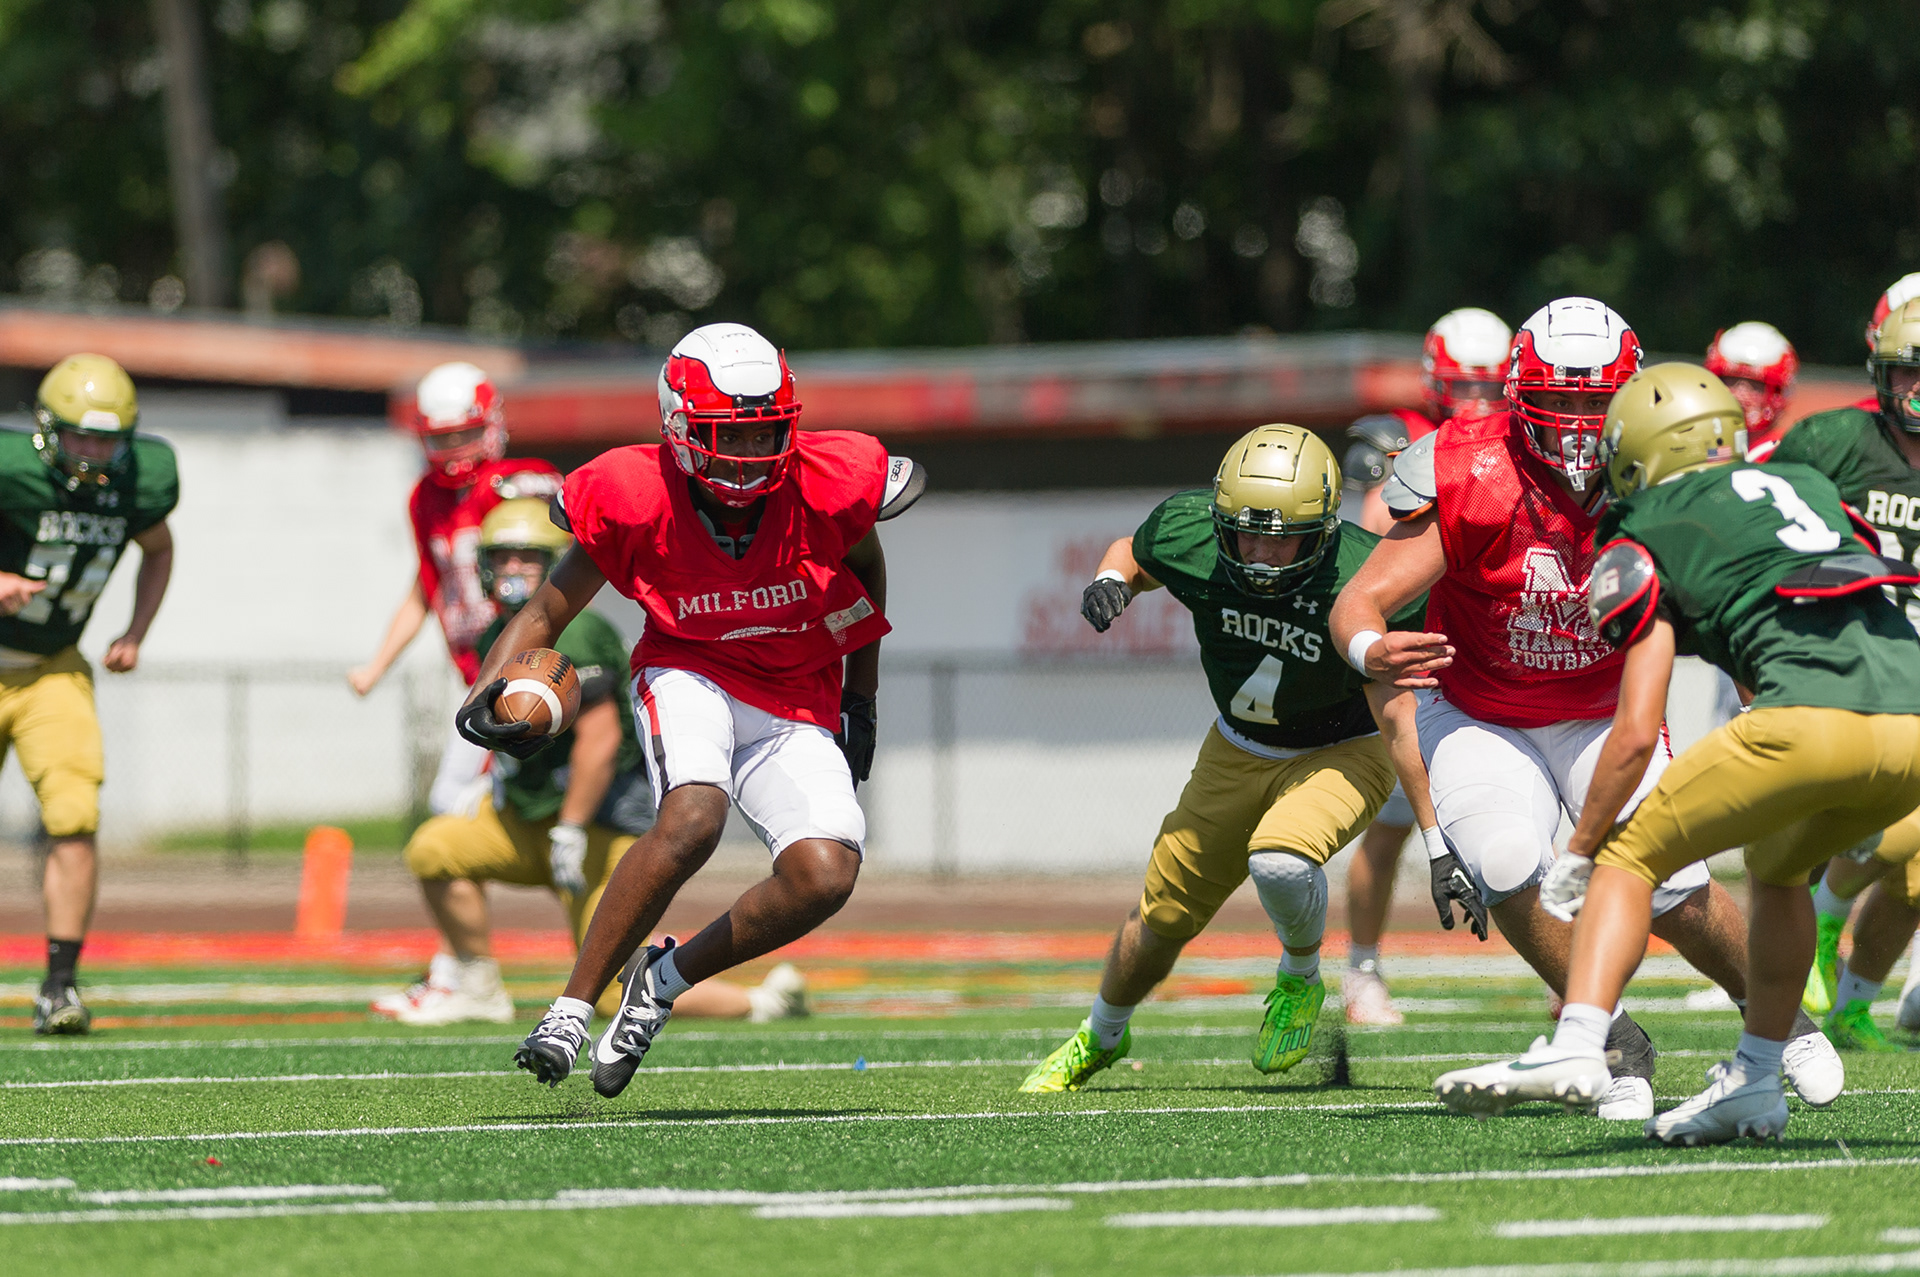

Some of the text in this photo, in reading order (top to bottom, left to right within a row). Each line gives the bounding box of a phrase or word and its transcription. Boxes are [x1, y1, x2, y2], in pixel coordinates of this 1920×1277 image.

[1731, 468, 1841, 553] 3
[677, 579, 808, 620] MILFORD
[1221, 607, 1323, 663] ROCKS
[1229, 653, 1284, 726] 4
